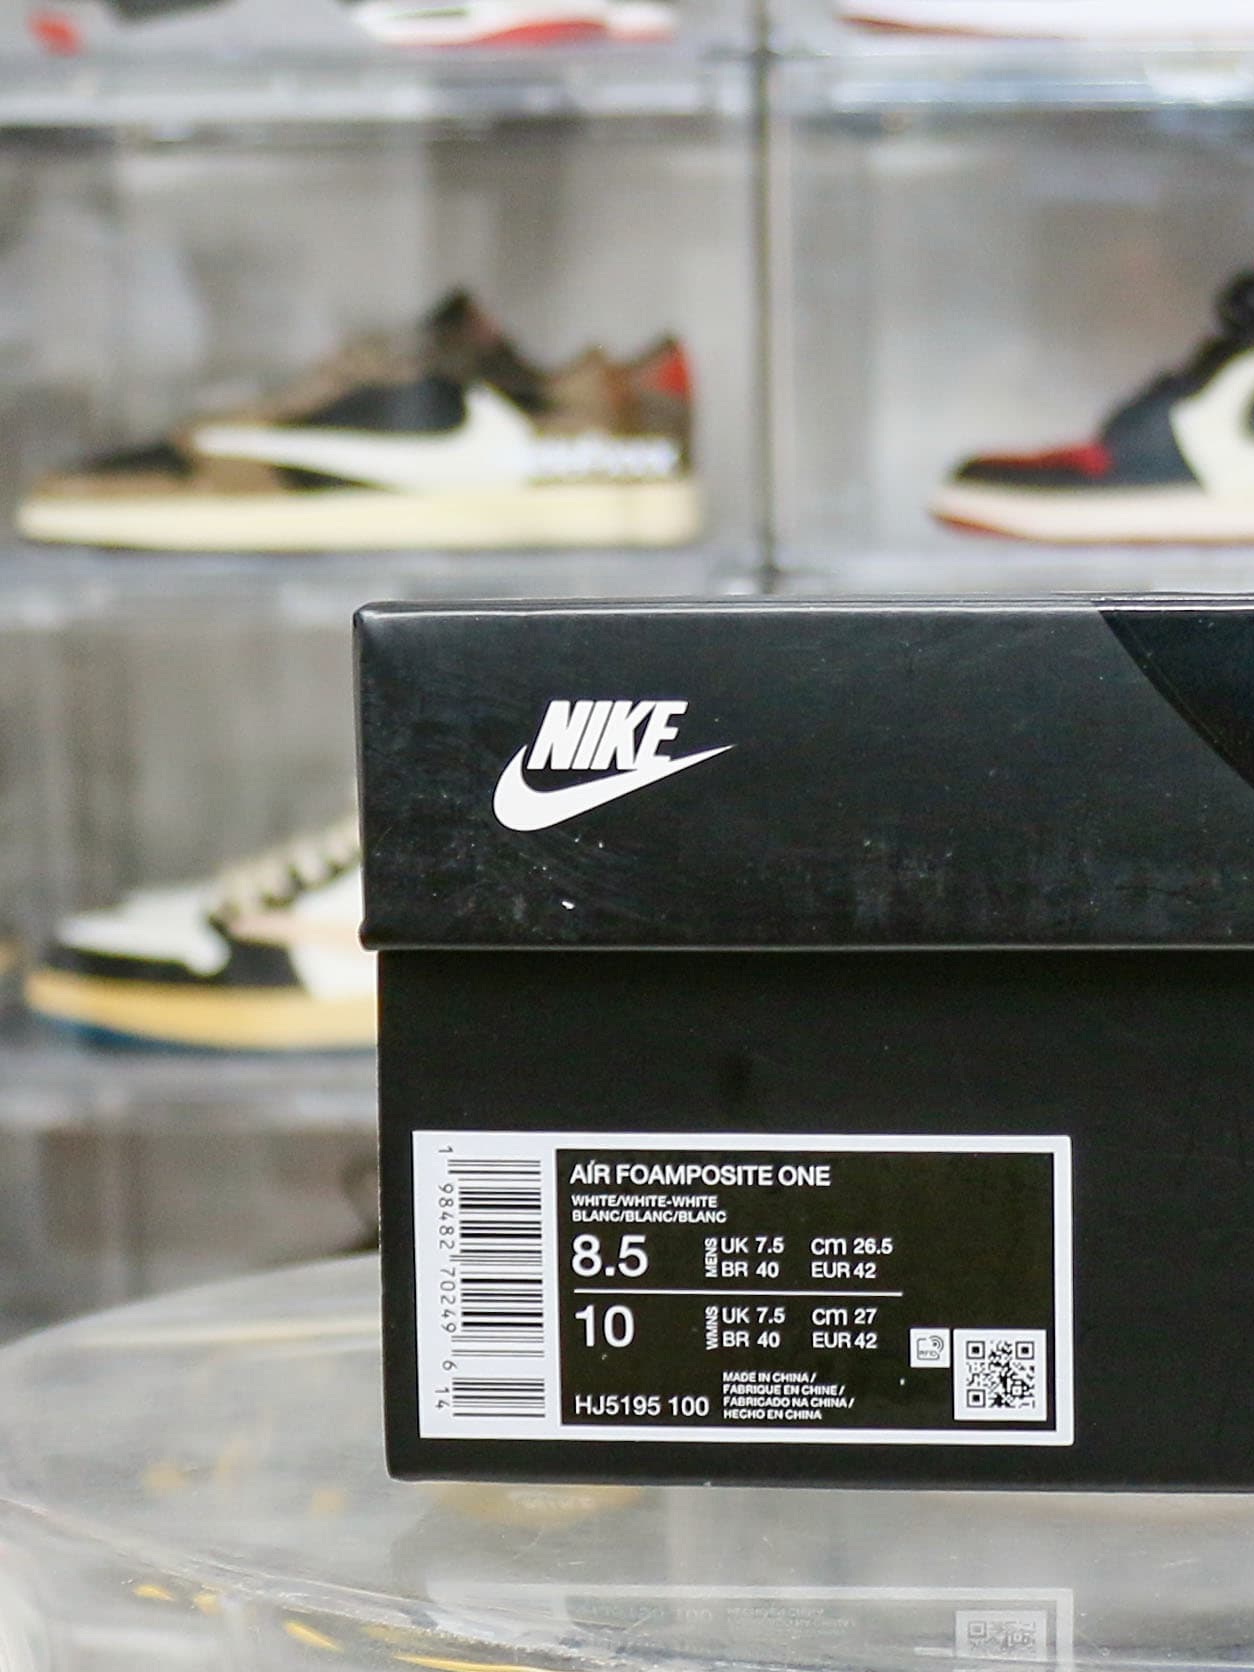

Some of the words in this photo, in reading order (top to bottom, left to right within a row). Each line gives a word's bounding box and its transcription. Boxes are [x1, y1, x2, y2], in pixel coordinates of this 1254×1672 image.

[527, 700, 688, 770] NIKE
[438, 1145, 453, 1153] 1
[616, 1164, 773, 1185] FOAMPOSITE
[778, 1165, 831, 1186] ONE
[571, 1195, 717, 1208] WHITE/WHITE-WHITE
[438, 1183, 454, 1249] 98482
[572, 1209, 727, 1223] BLANC/BLANC/BLANC
[721, 1237, 748, 1253] UK
[756, 1237, 784, 1253] 7.5
[854, 1238, 893, 1254] 26.5
[572, 1234, 648, 1277] 8.5
[705, 1238, 717, 1277] MENS
[722, 1261, 748, 1277] BR
[756, 1261, 779, 1278] 40
[812, 1261, 850, 1278] EUR
[854, 1262, 876, 1278] 42
[439, 1267, 456, 1333] 70249
[723, 1307, 749, 1323] UK
[757, 1307, 785, 1323] 7.5
[855, 1308, 877, 1324] 27
[576, 1305, 634, 1347] 10
[705, 1306, 718, 1350] WMNS
[723, 1331, 749, 1347] BR
[757, 1331, 780, 1347] 40
[813, 1332, 851, 1348] EUR
[854, 1332, 877, 1349] 42
[442, 1360, 458, 1371] 6
[723, 1372, 756, 1382] MADE
[758, 1373, 770, 1382] IN
[772, 1372, 809, 1382] CHINA
[723, 1384, 781, 1395] FABRIQUE
[784, 1385, 799, 1395] EN
[801, 1385, 837, 1395] CHINE
[434, 1387, 450, 1409] 14
[576, 1395, 660, 1416] HJ5195
[668, 1396, 709, 1416] 100
[724, 1396, 790, 1407] FABRICADO
[792, 1397, 809, 1407] NA
[810, 1397, 847, 1408] CHINA
[724, 1409, 765, 1419] HECHO
[767, 1409, 783, 1419] EN
[785, 1409, 822, 1420] CHINA
